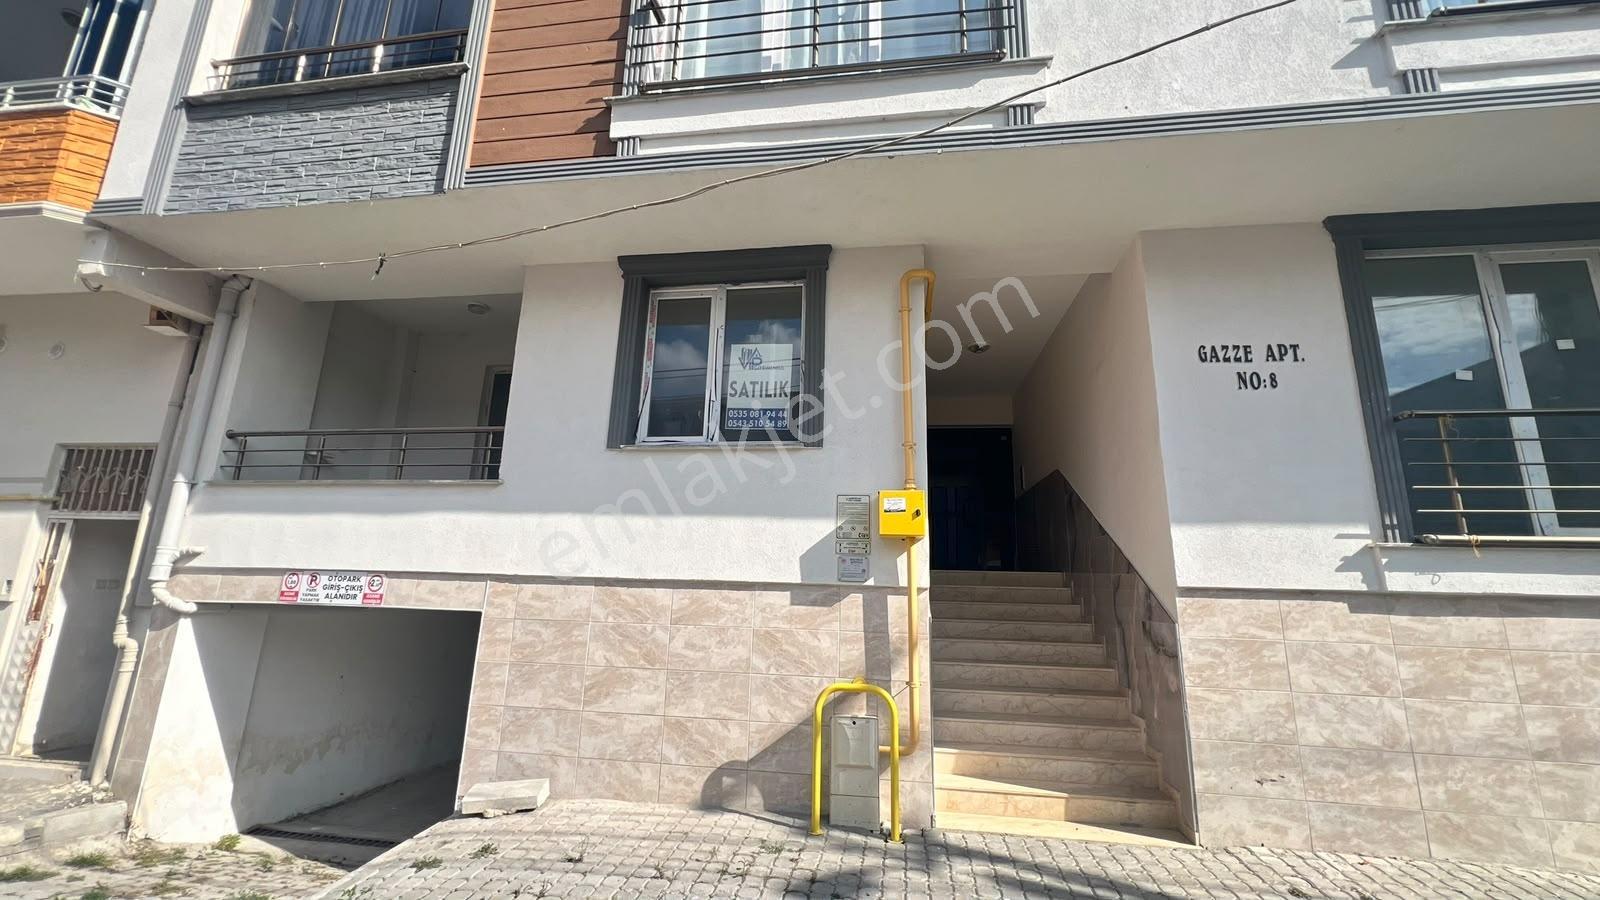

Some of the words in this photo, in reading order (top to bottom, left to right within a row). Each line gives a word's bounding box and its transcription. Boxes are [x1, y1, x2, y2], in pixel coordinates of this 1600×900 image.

[1198, 345, 1253, 363] GAZZE
[1265, 344, 1305, 362] APT.
[729, 381, 789, 398] SATILIK
[1236, 371, 1278, 390] NO:8
[729, 410, 748, 418] 0535
[750, 410, 763, 418] 081
[766, 410, 776, 418] 94
